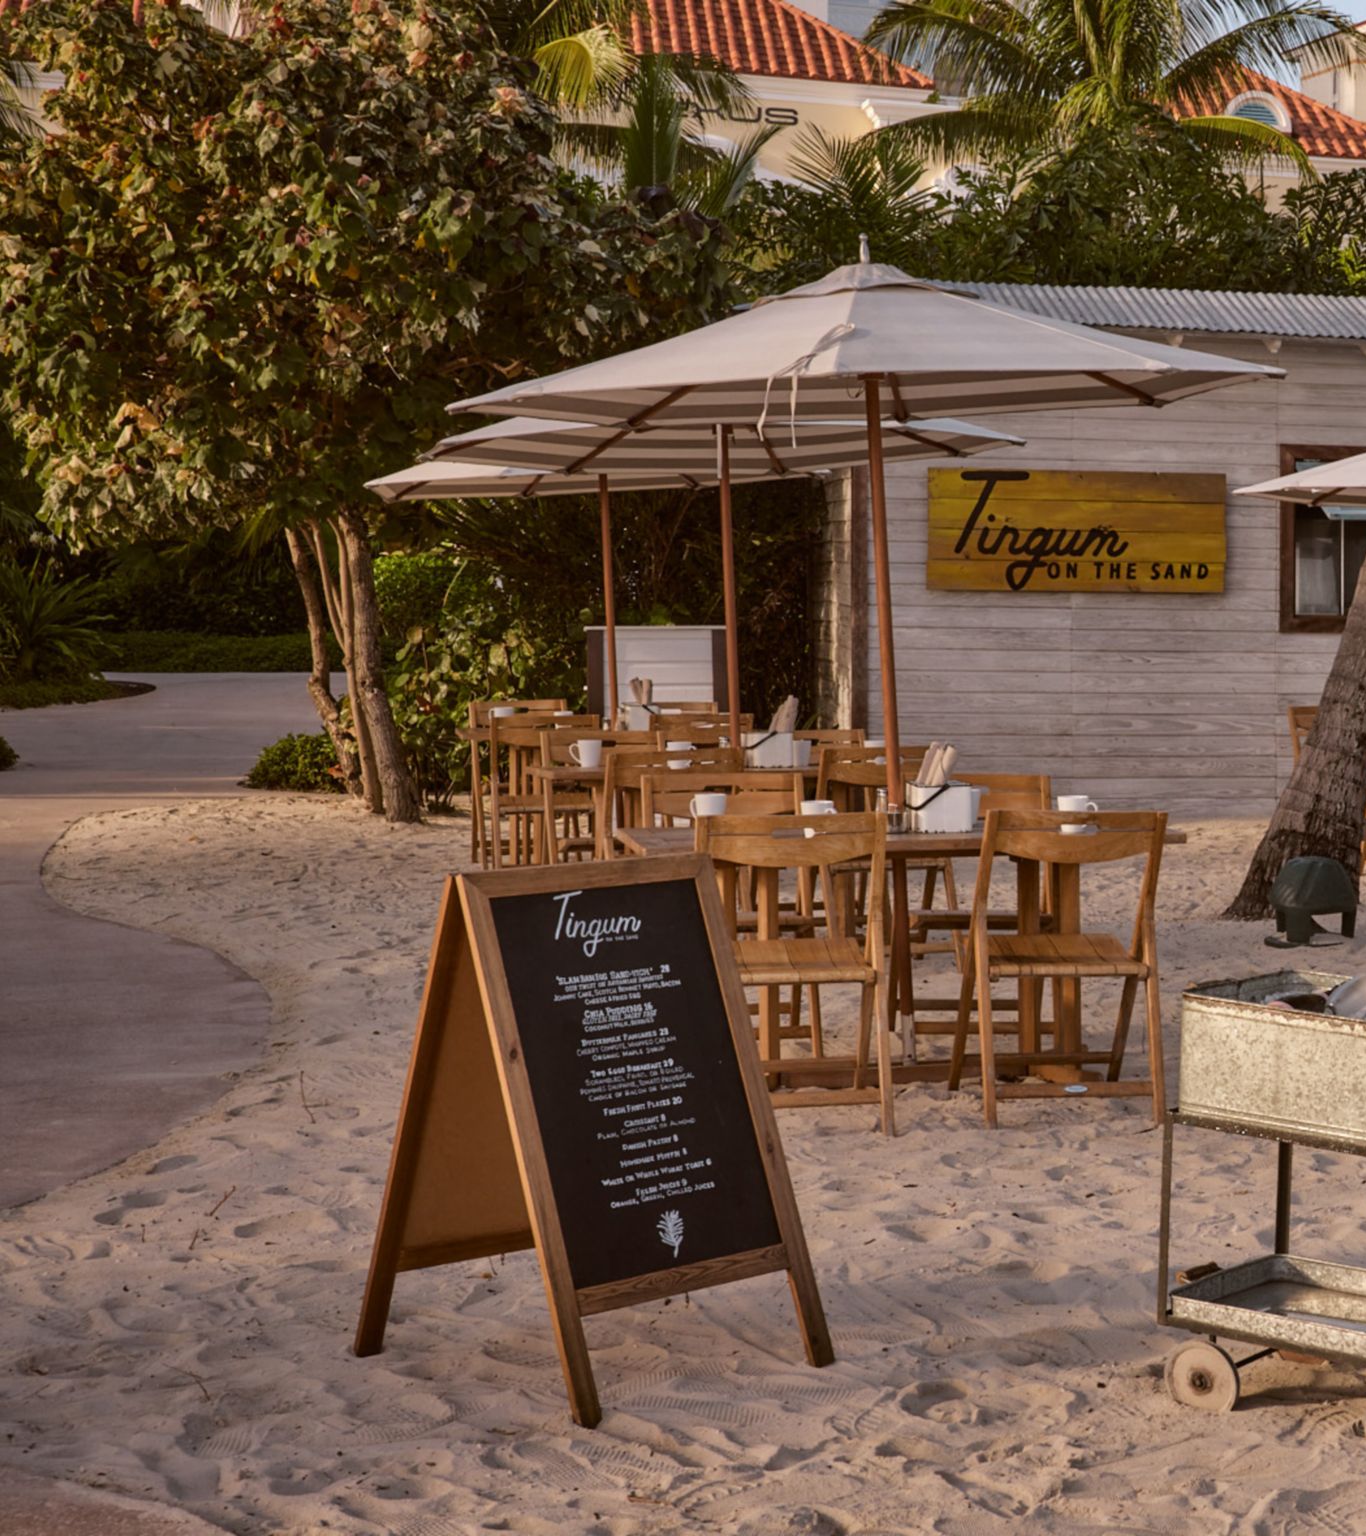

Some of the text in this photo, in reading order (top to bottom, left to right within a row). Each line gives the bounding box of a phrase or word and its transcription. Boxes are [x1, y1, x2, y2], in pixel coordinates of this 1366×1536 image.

[955, 471, 1128, 591] Tingum
[1047, 562, 1209, 579] ON THE SAND
[553, 890, 641, 957] Tingum
